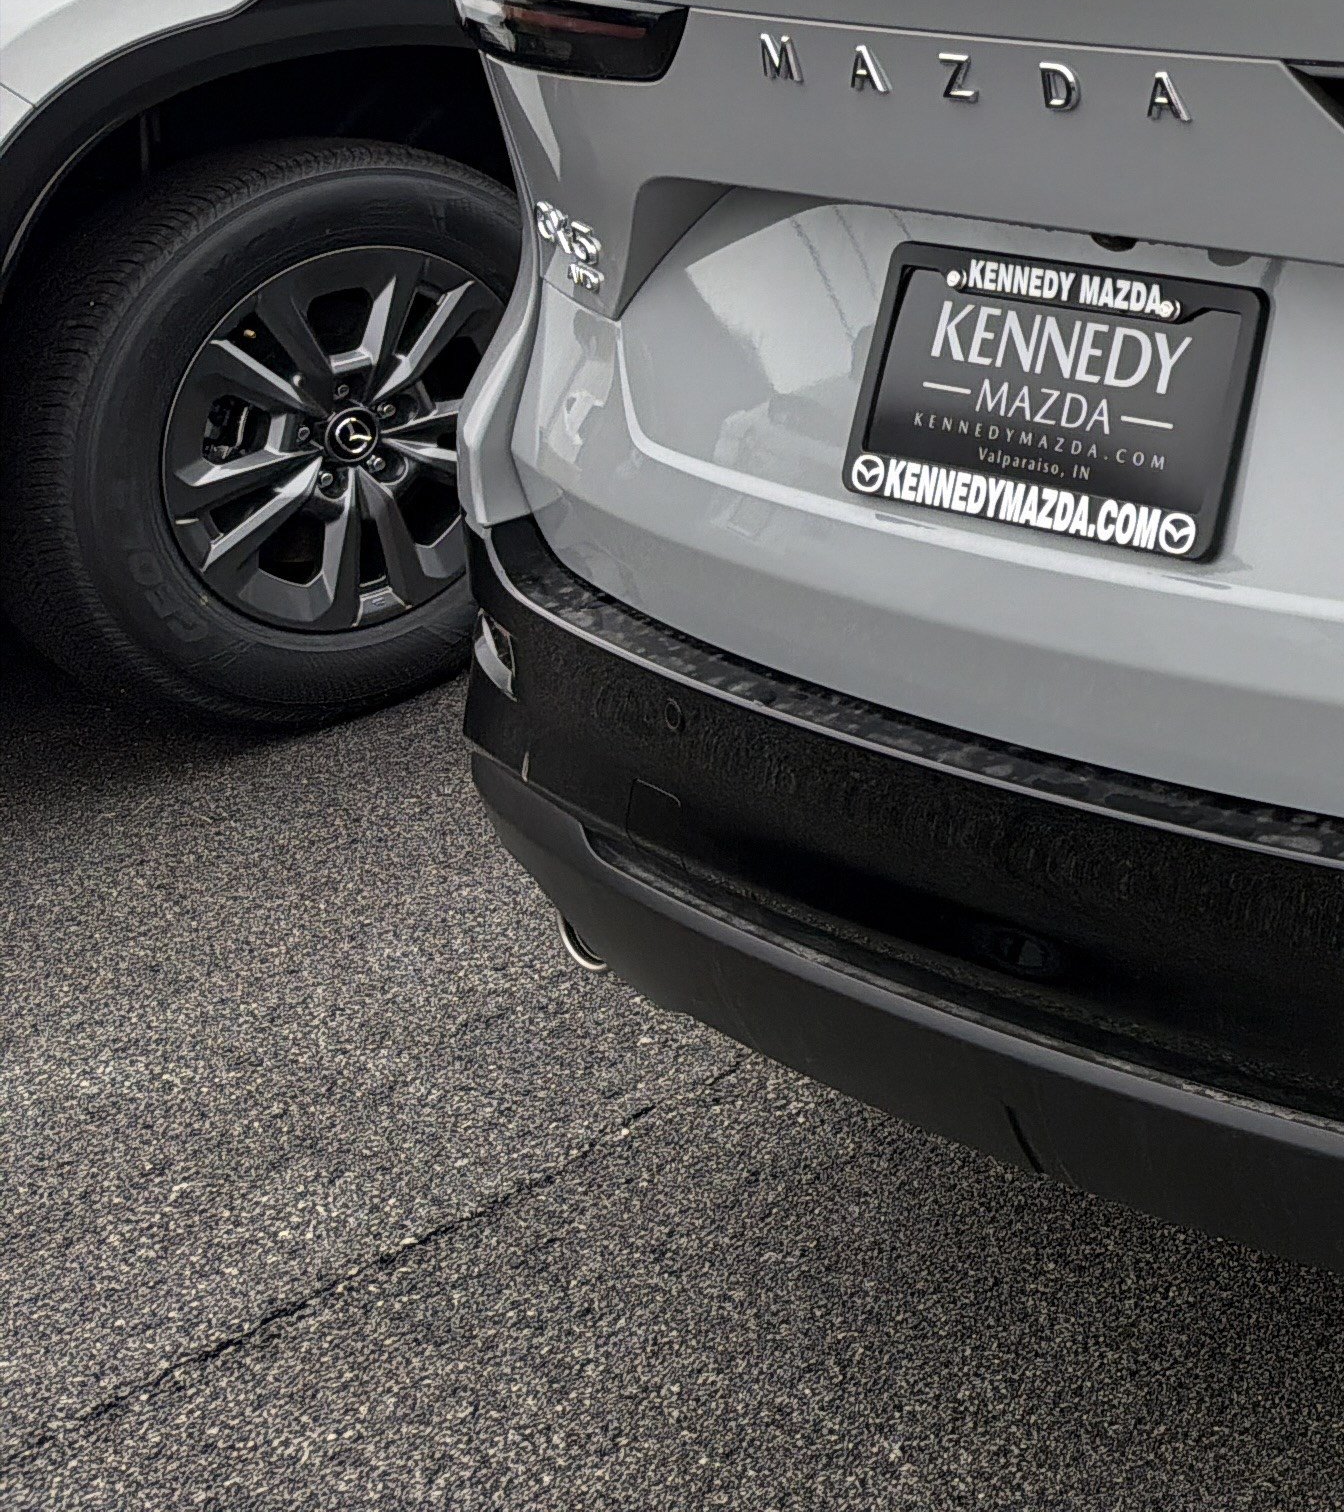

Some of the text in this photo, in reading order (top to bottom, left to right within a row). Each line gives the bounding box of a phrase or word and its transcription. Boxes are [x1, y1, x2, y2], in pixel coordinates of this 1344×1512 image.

[759, 32, 1192, 123] MAZDA
[967, 258, 1163, 316] KENNEDY MAZDA
[930, 300, 1193, 395] KENNEDY
[974, 378, 1112, 435] MAZDA
[913, 411, 1166, 471] KENNEDYMAZDA.COM
[977, 446, 1091, 481] Valparaiso, IN
[884, 459, 1161, 550] KENNEDYMAZDA.COM
